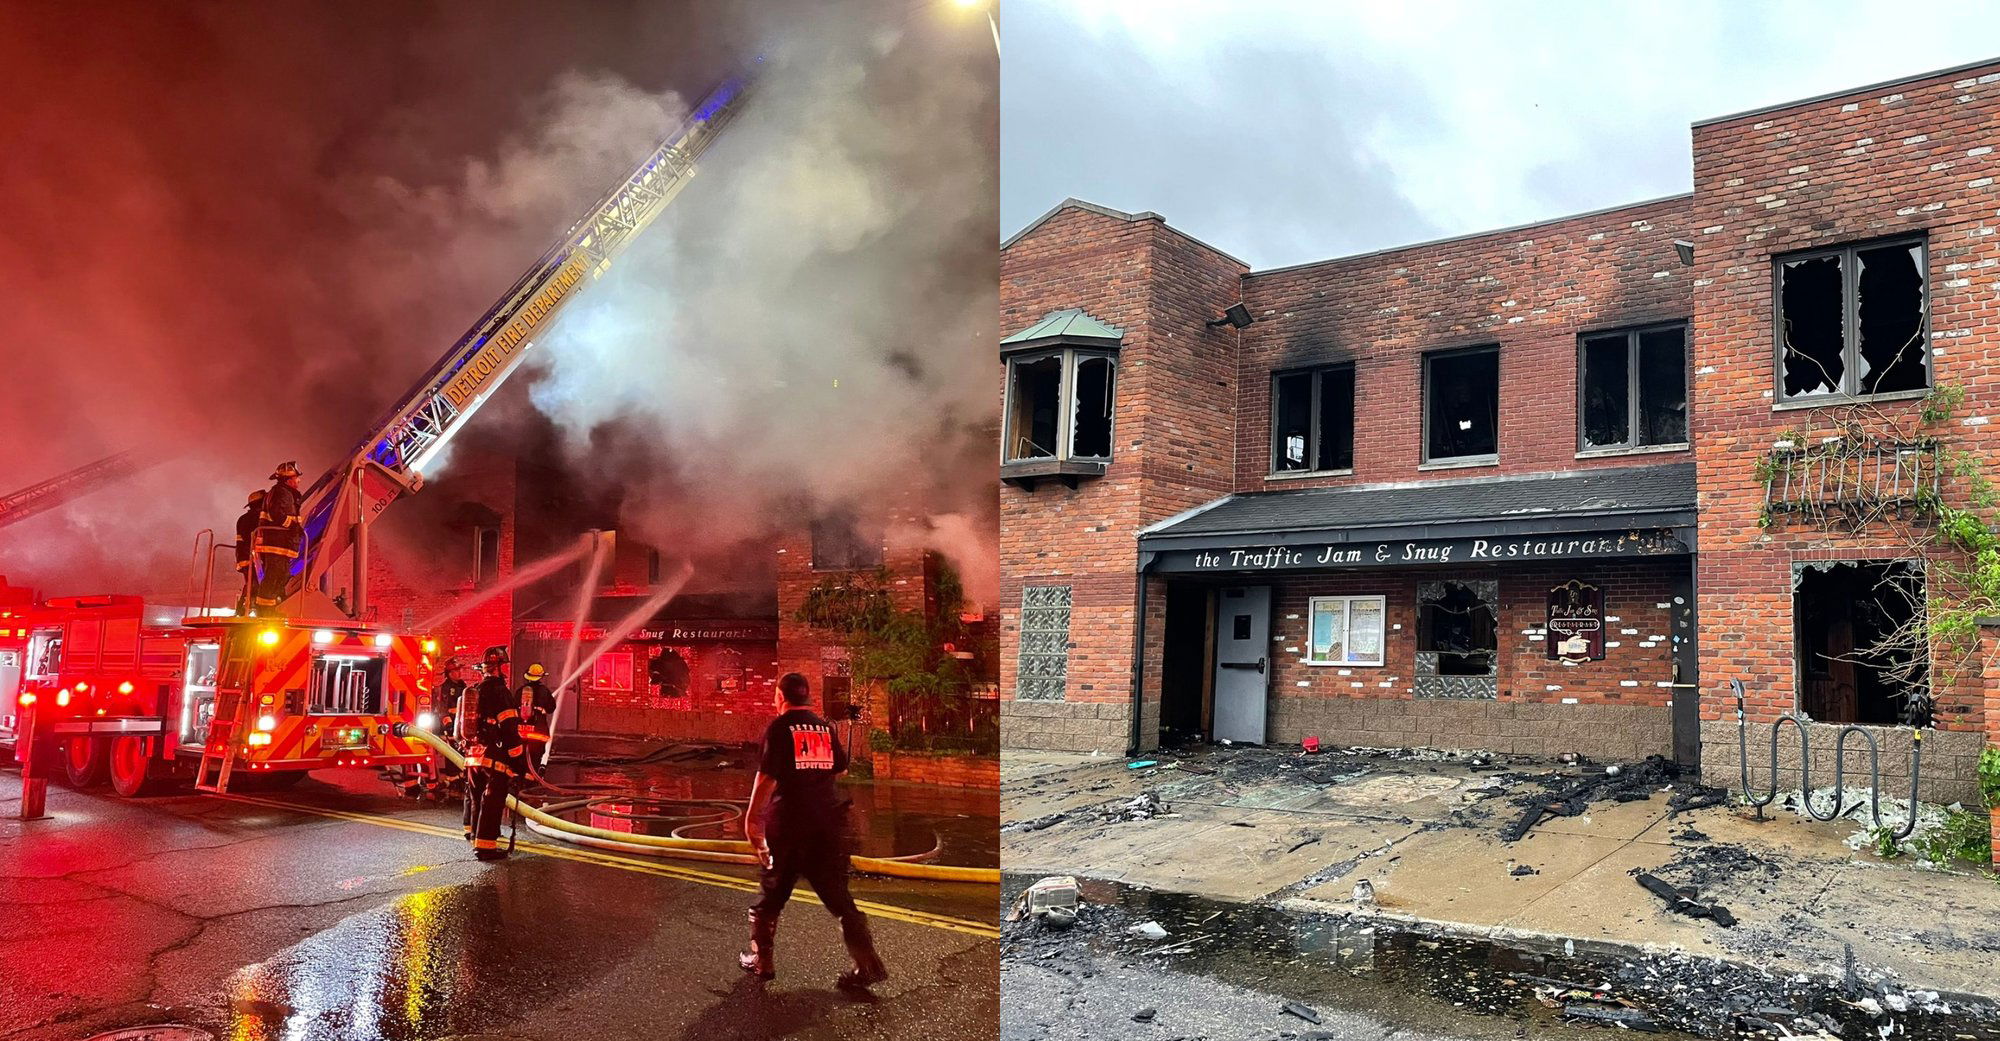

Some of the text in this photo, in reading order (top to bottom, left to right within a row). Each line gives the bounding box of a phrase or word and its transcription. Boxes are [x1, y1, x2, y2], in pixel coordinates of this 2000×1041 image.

[446, 254, 592, 406] DETROIT FIRE DEPARTMENT
[371, 498, 387, 514] 100
[1195, 535, 1626, 569] the Traffic Jam & Snug Restaurant
[640, 628, 665, 639] Snug
